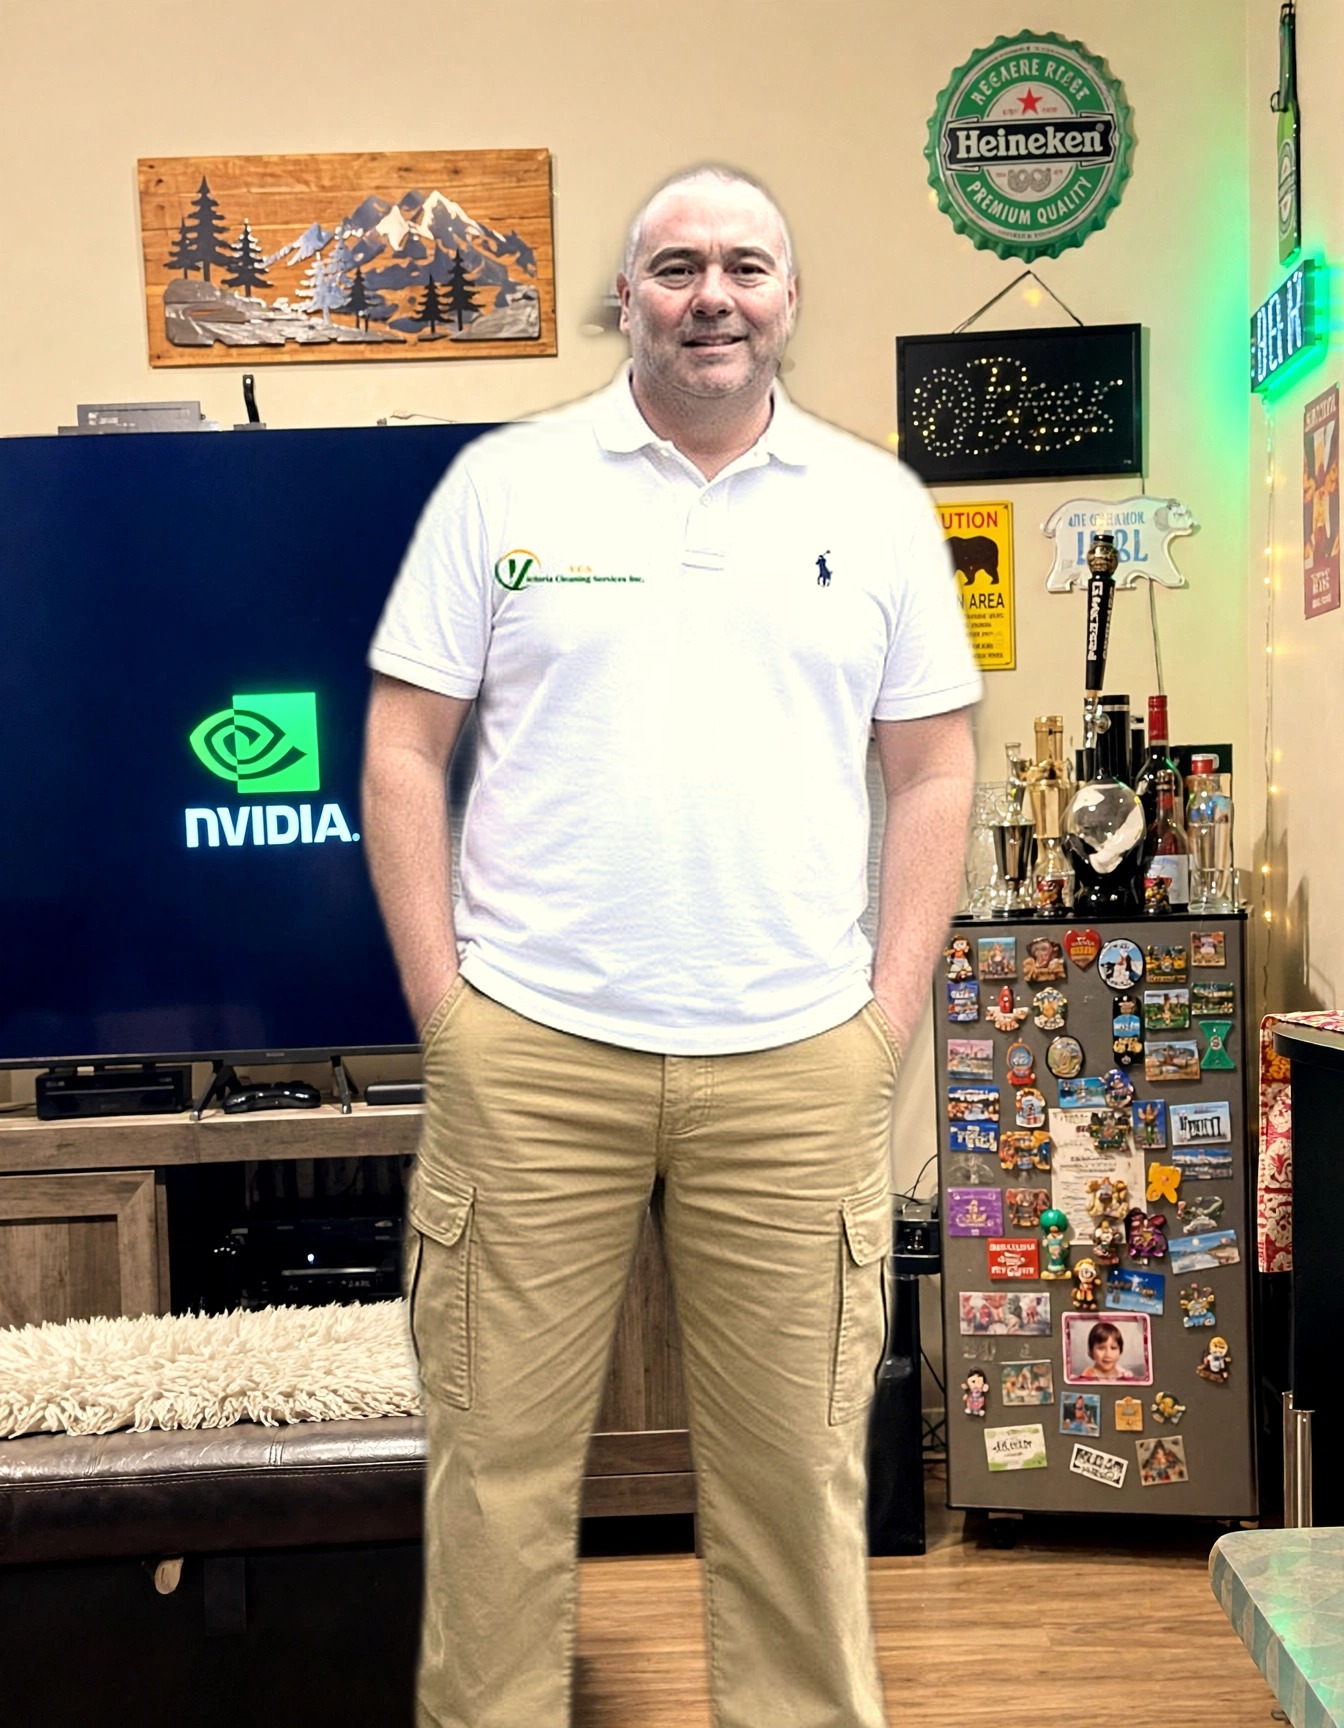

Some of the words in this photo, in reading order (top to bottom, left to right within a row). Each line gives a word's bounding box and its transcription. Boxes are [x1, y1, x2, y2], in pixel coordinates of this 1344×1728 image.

[956, 126, 1104, 159] Heineken
[966, 180, 1031, 225] PREMIUM
[1036, 176, 1092, 224] QUALITY
[936, 511, 998, 530] UTION
[555, 575, 591, 583] Cleaning
[593, 574, 627, 583] Services
[969, 592, 1005, 609] AREA
